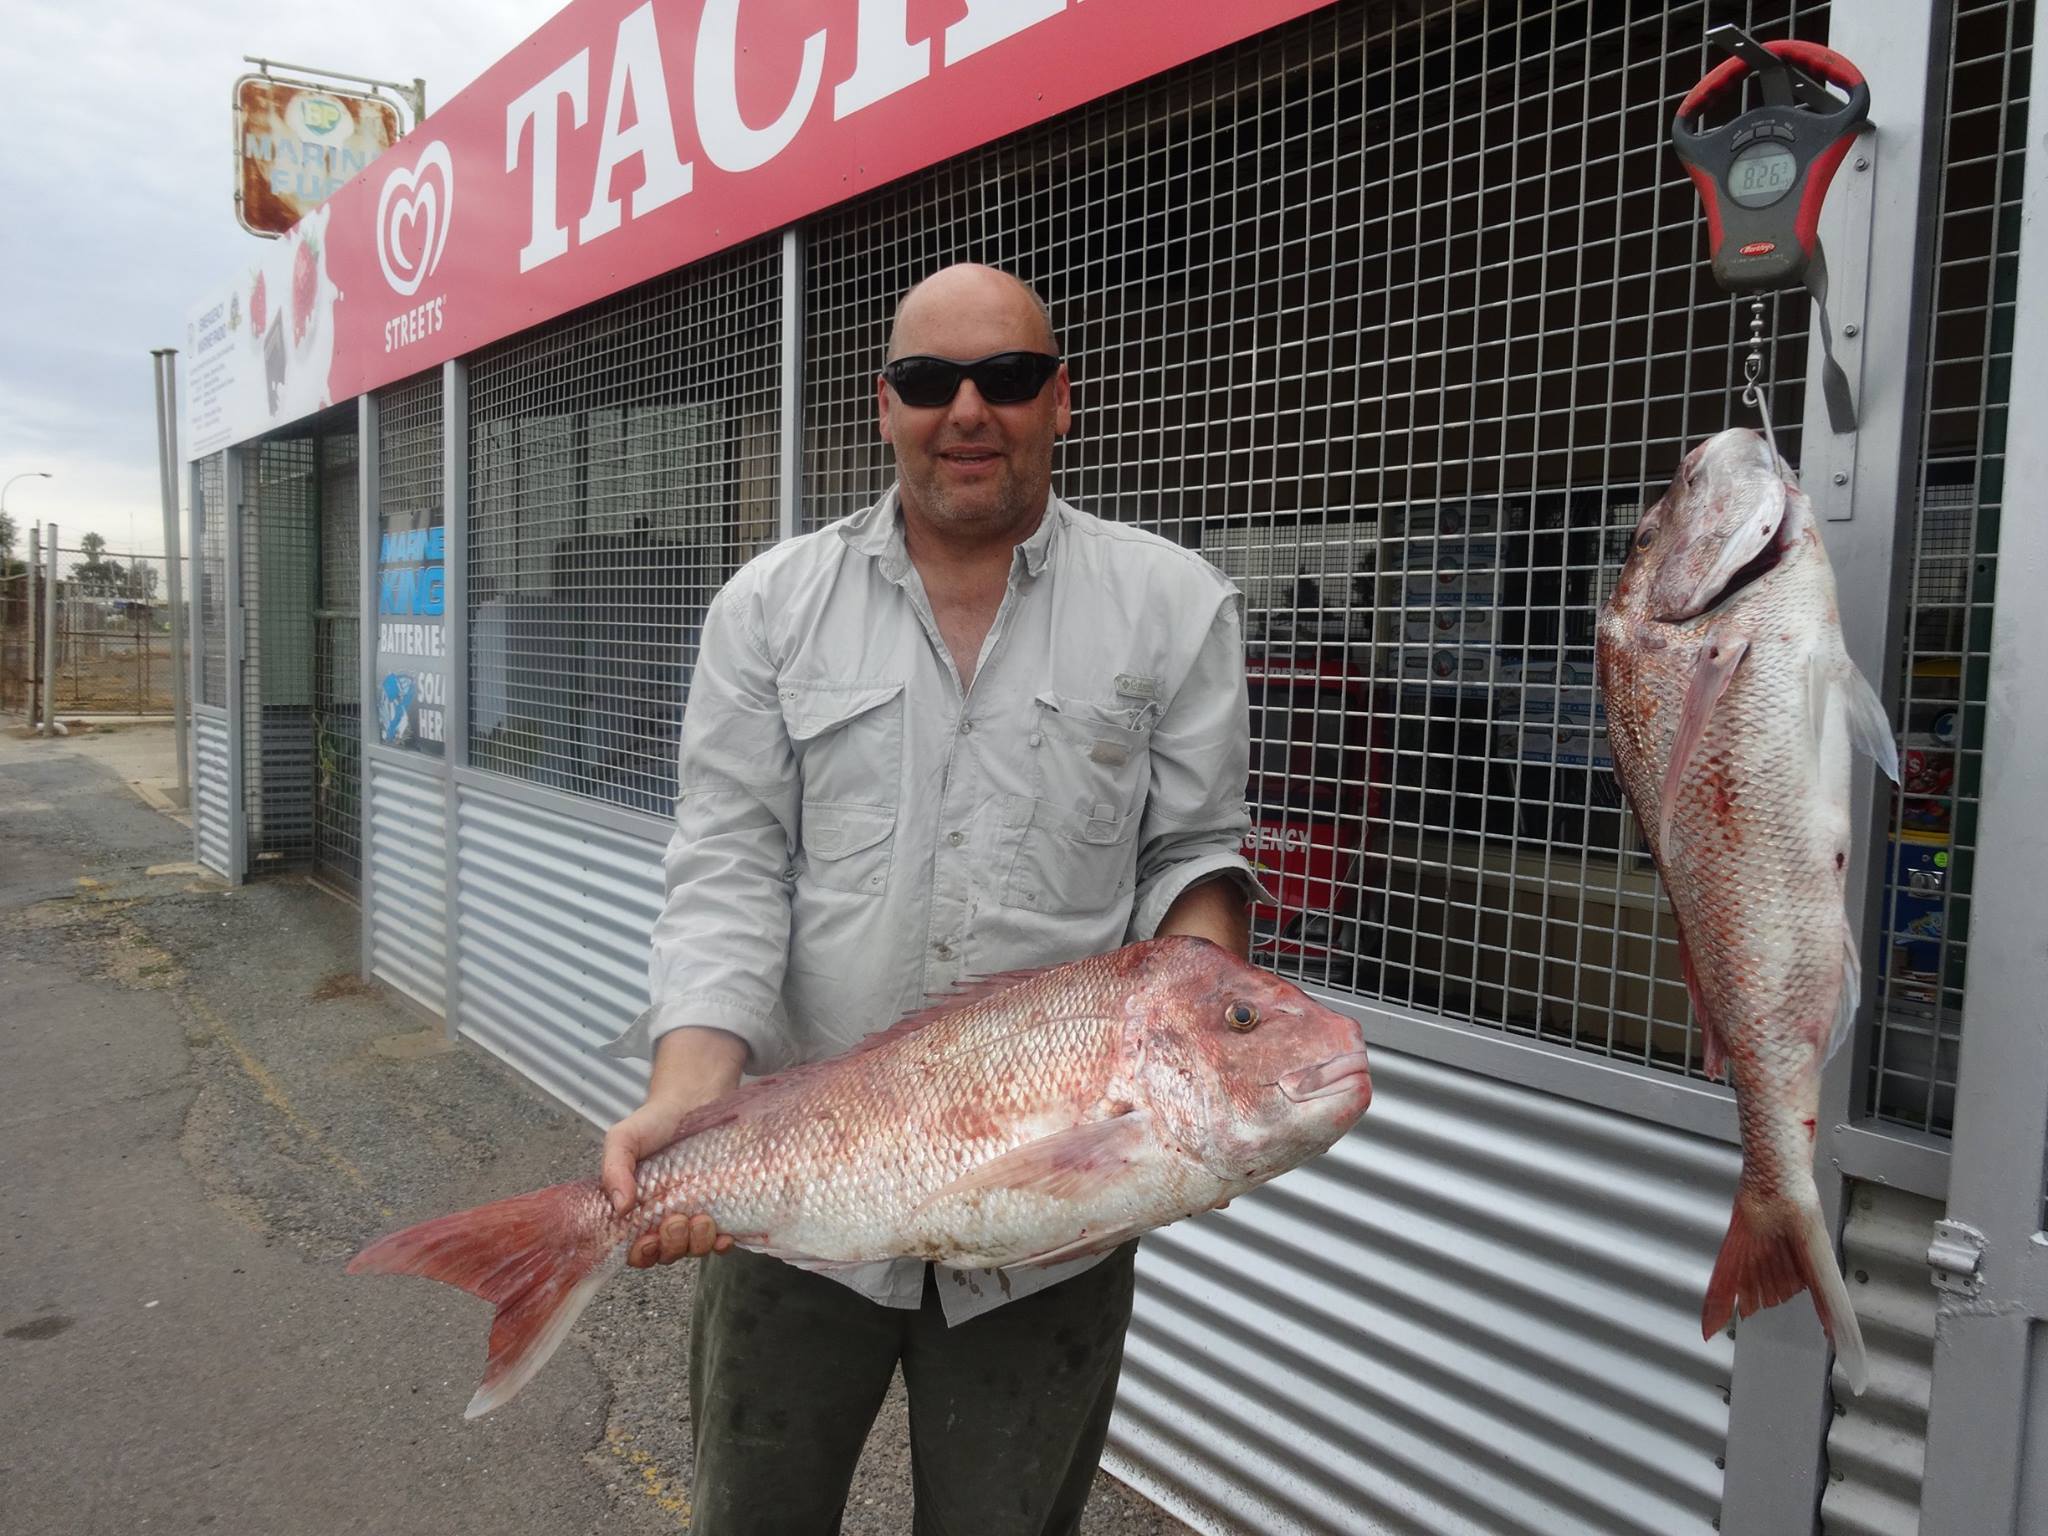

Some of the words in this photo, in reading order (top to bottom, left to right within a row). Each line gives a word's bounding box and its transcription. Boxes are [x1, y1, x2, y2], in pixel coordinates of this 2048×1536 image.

[306, 102, 341, 129] BP
[246, 133, 383, 171] MARIN
[385, 297, 443, 353] STREETS
[418, 671, 446, 705] SOL
[418, 708, 446, 742] HER
